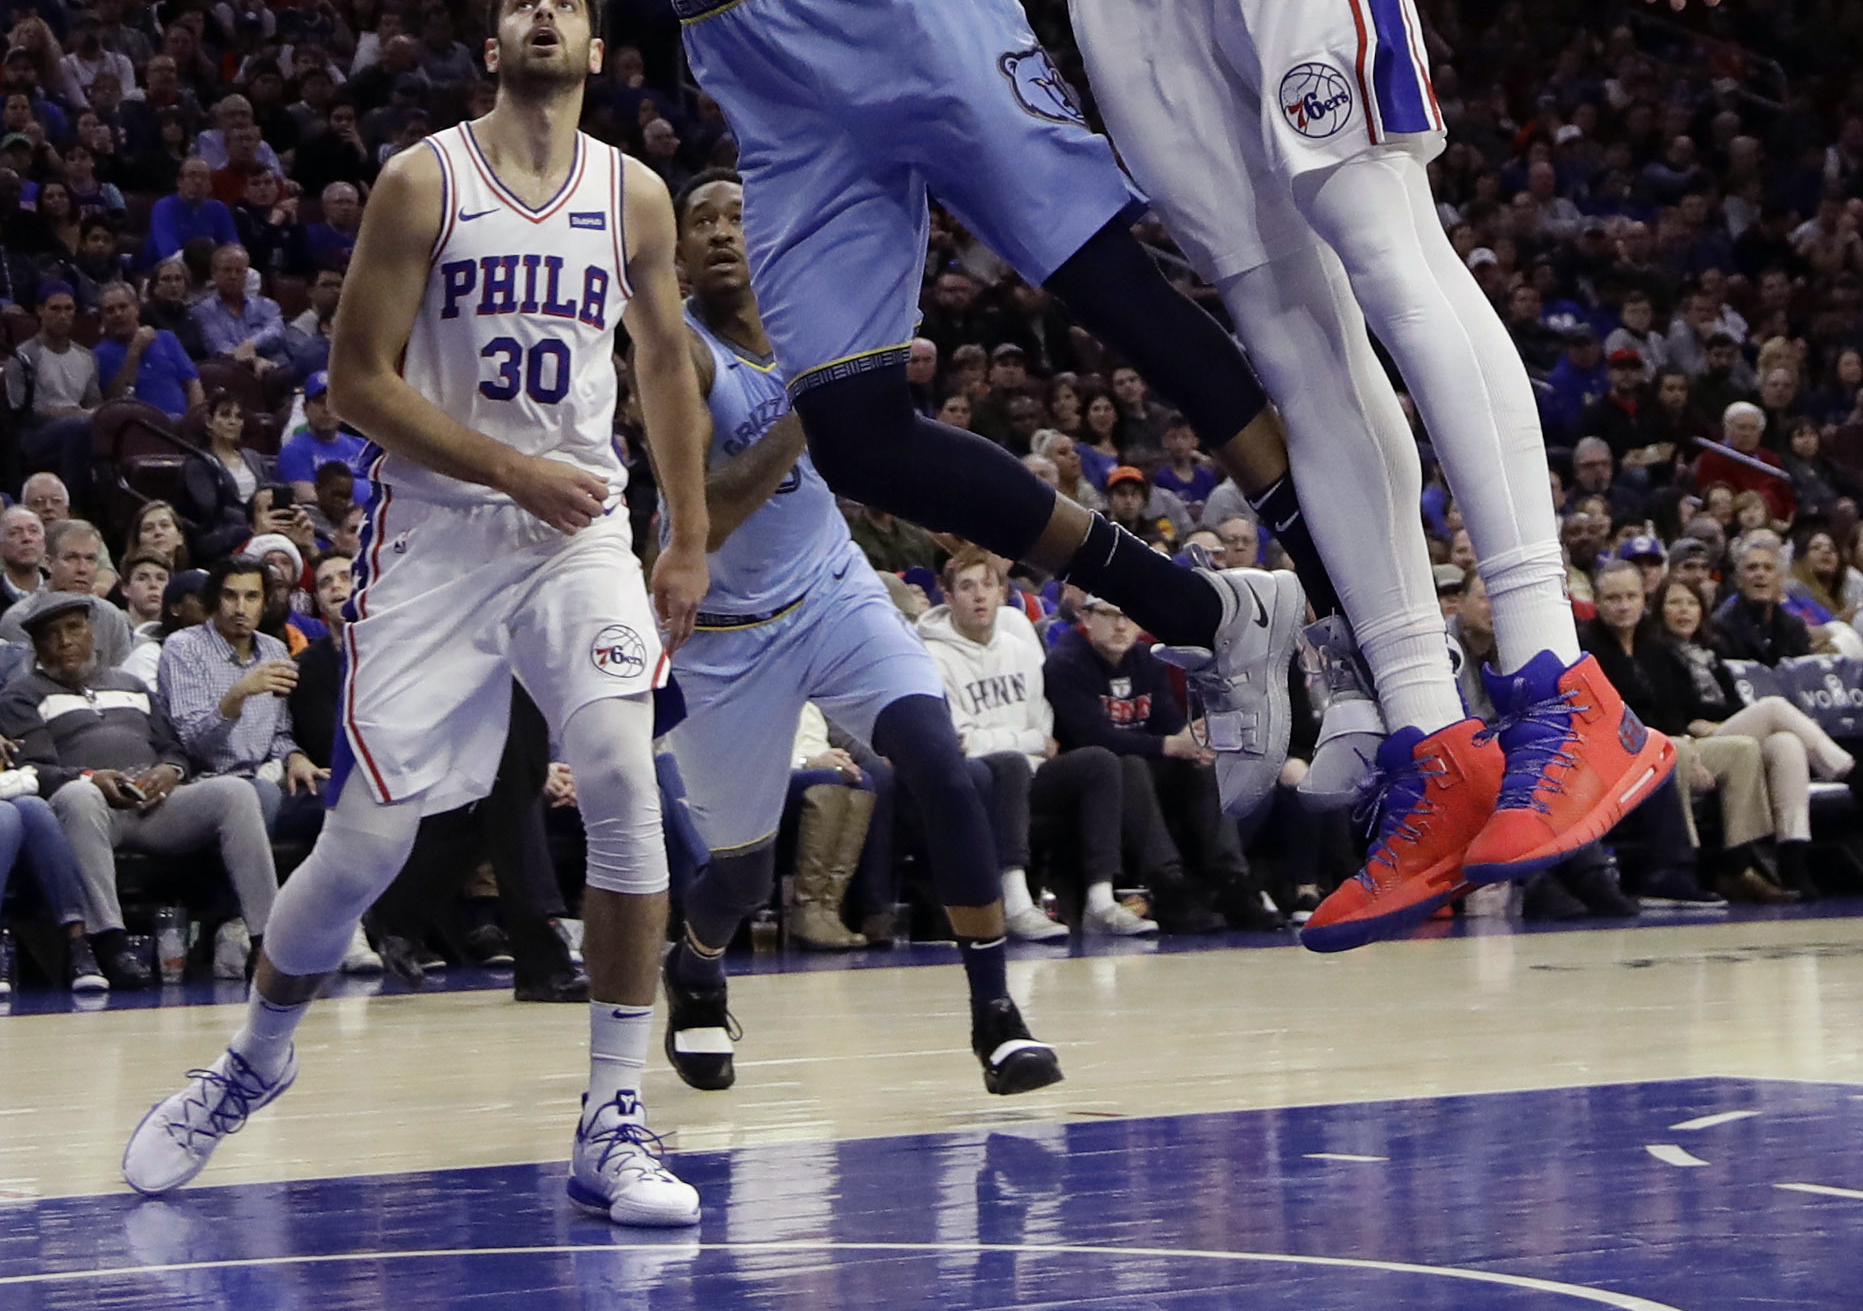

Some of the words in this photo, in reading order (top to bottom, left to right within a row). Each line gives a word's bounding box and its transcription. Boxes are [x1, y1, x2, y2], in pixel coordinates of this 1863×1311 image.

[1285, 91, 1349, 129] 76ers
[441, 254, 609, 331] PHILA
[480, 337, 571, 404] 30
